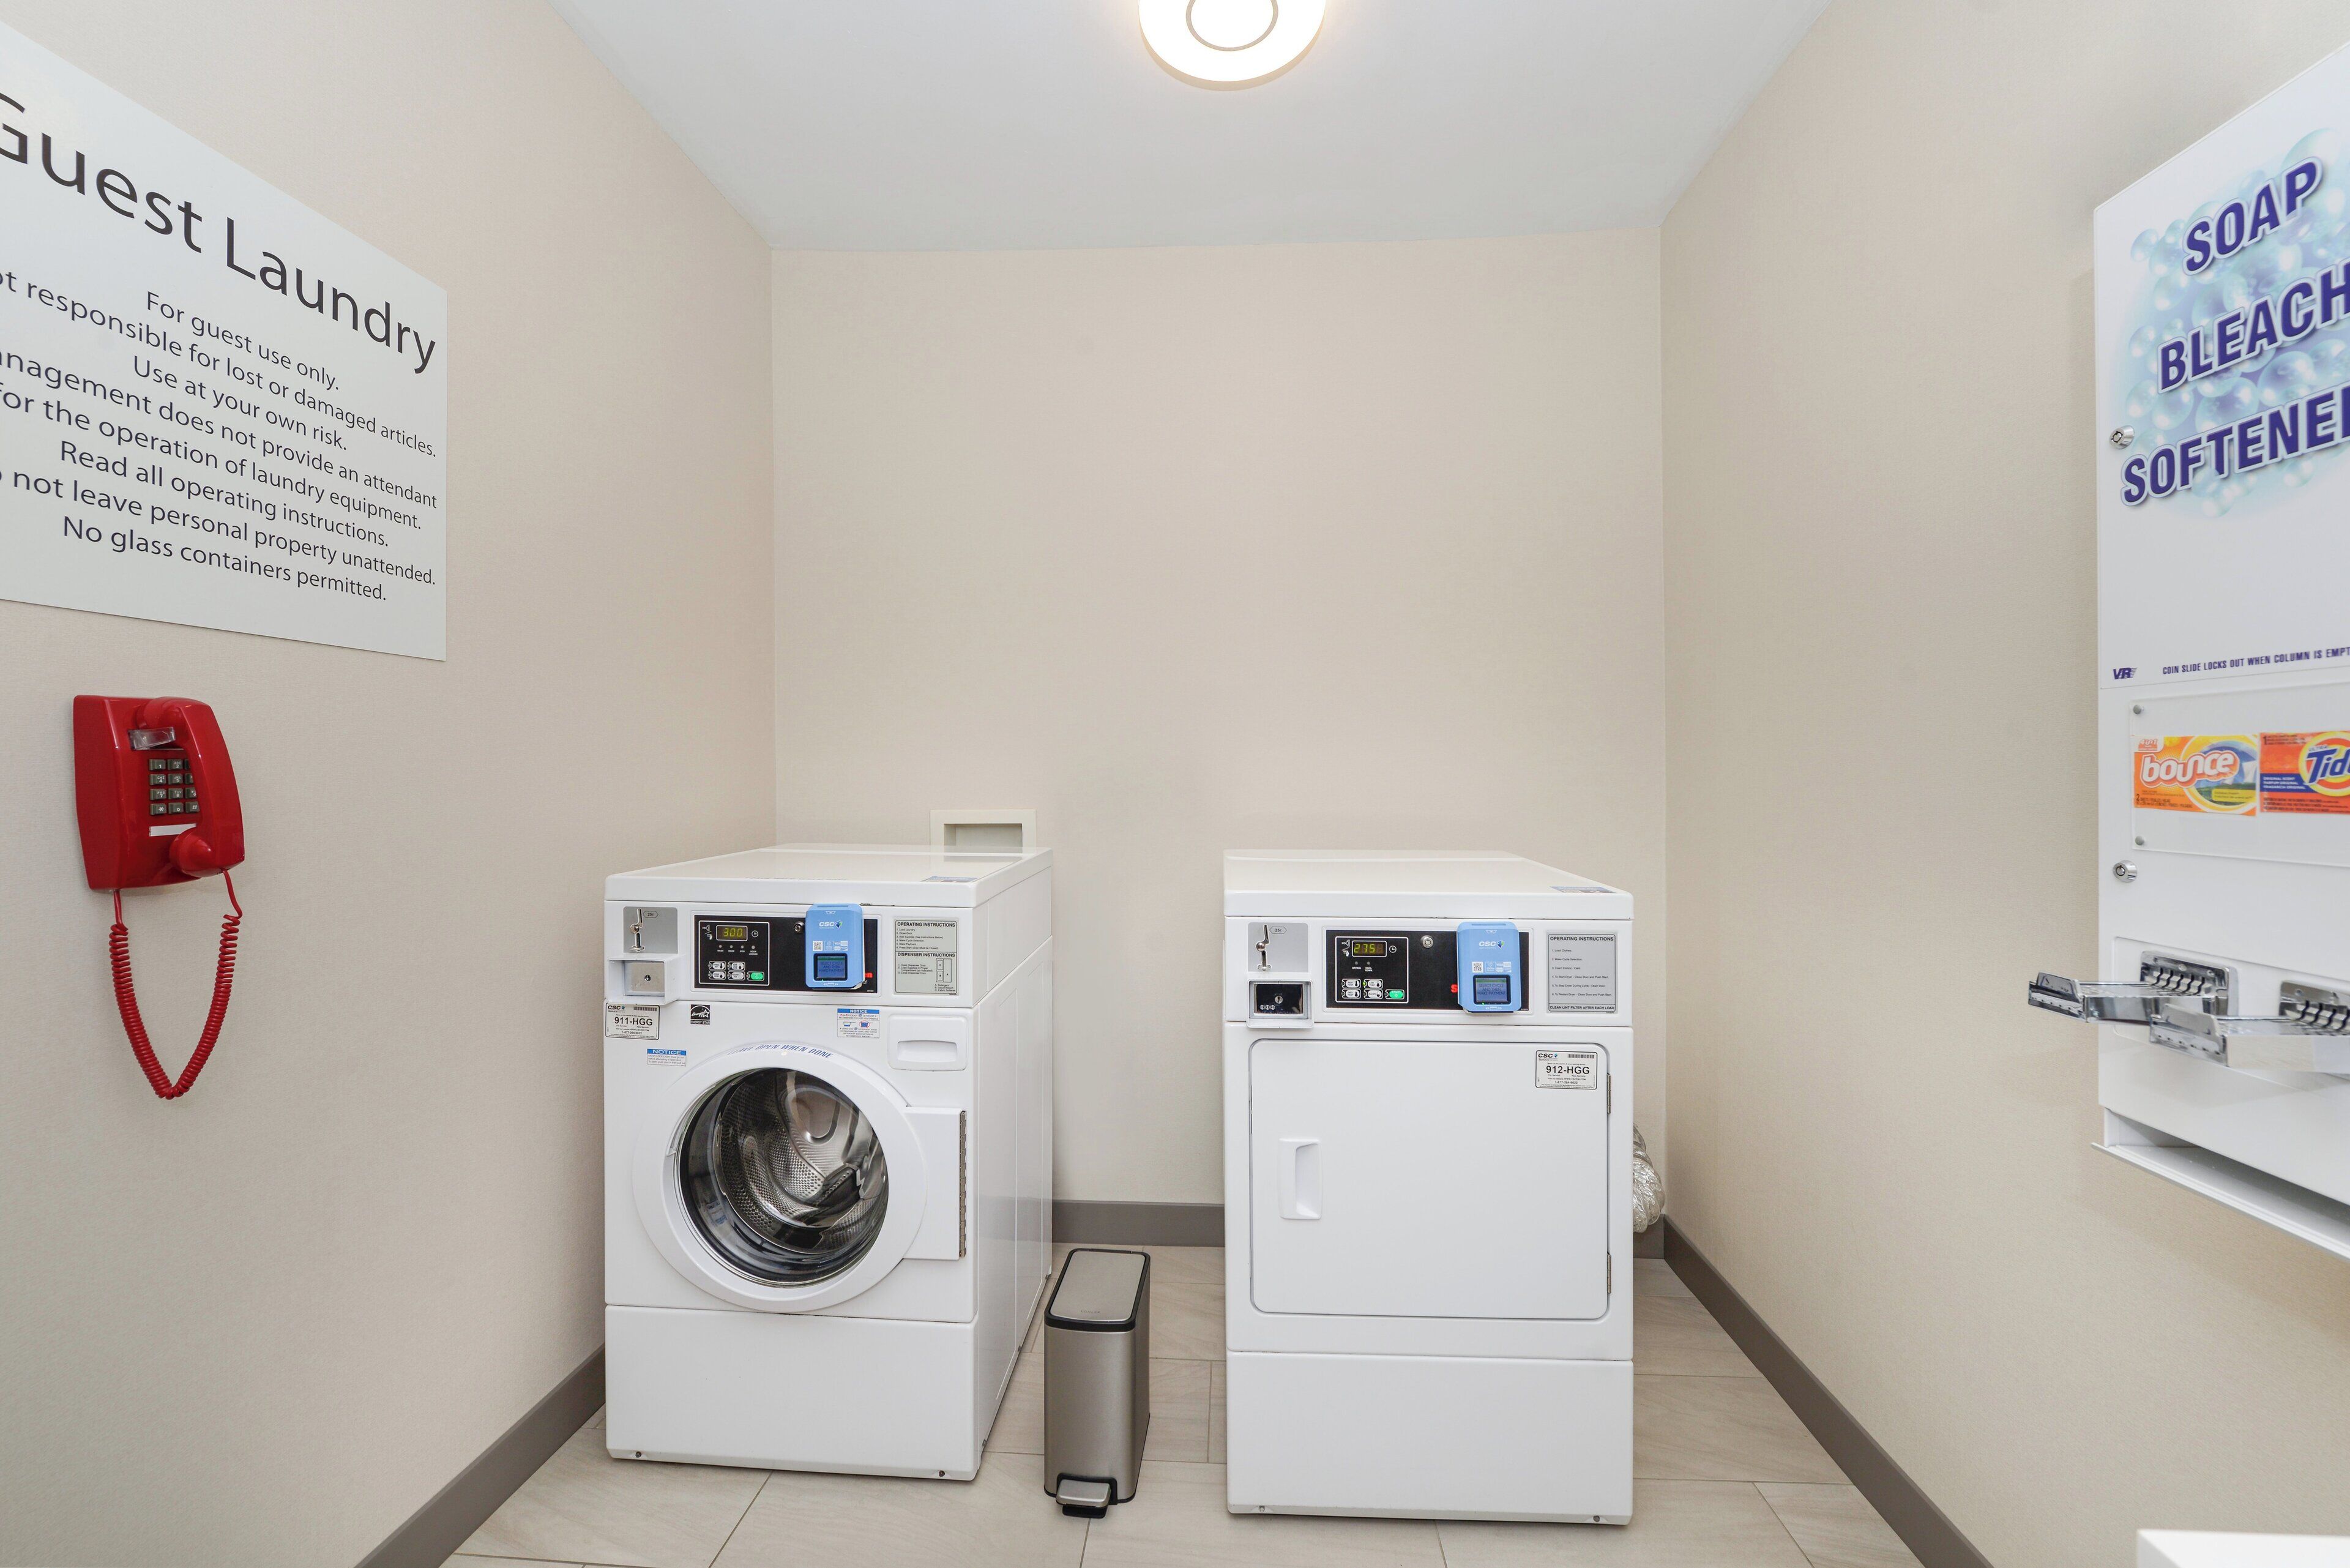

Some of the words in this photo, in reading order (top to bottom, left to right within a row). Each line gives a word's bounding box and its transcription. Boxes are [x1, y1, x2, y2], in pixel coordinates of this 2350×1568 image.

[2185, 159, 2320, 274] SOAP
[147, 291, 185, 323] For
[191, 316, 252, 354] guest
[258, 345, 291, 370] use
[297, 362, 339, 390] only.
[226, 217, 436, 374] Laundry
[2159, 258, 2350, 393] BLEACH
[28, 282, 182, 357] responsible
[188, 343, 220, 371] for
[227, 357, 263, 389] lost
[269, 381, 289, 398] or
[294, 388, 376, 434] damaged
[381, 425, 436, 457] articles.
[134, 355, 177, 389] Use
[184, 380, 206, 400] at
[212, 389, 260, 418] your
[266, 411, 307, 436] own
[313, 425, 346, 450] risk.
[0, 351, 152, 415] nagement
[159, 401, 214, 435] does
[222, 425, 256, 449] not
[263, 439, 334, 474] provide
[338, 466, 359, 483] an
[364, 474, 437, 509] attendant
[43, 400, 90, 431] the
[99, 421, 218, 469] operation
[225, 458, 247, 477] of
[252, 461, 325, 504] laundry
[330, 492, 421, 529] equipment.
[13, 471, 64, 498] not
[73, 479, 143, 516] leave
[151, 505, 247, 541] personal
[255, 531, 337, 566] property
[342, 552, 435, 585] unattended.
[61, 440, 127, 477] Read
[136, 465, 163, 487] all
[171, 477, 276, 521] operating
[283, 502, 388, 547] instructions.
[64, 515, 102, 542] No
[111, 529, 173, 557] glass
[180, 547, 291, 581] containers
[297, 570, 386, 601] permitted.
[2163, 665, 2179, 674] COIN
[2182, 663, 2201, 673] SLIDE
[2204, 660, 2227, 670] LOCKS
[2229, 659, 2244, 668] OUT
[2247, 655, 2270, 666] WHEN
[2274, 651, 2310, 663] COLUMN
[2314, 650, 2322, 659] IS
[2141, 752, 2236, 784] bounce
[723, 928, 742, 937] 300
[1354, 944, 1375, 953] 275
[614, 1017, 653, 1026] 911-HGG
[808, 1048, 834, 1059] DONE
[1546, 1065, 1590, 1075] 912-HGG
